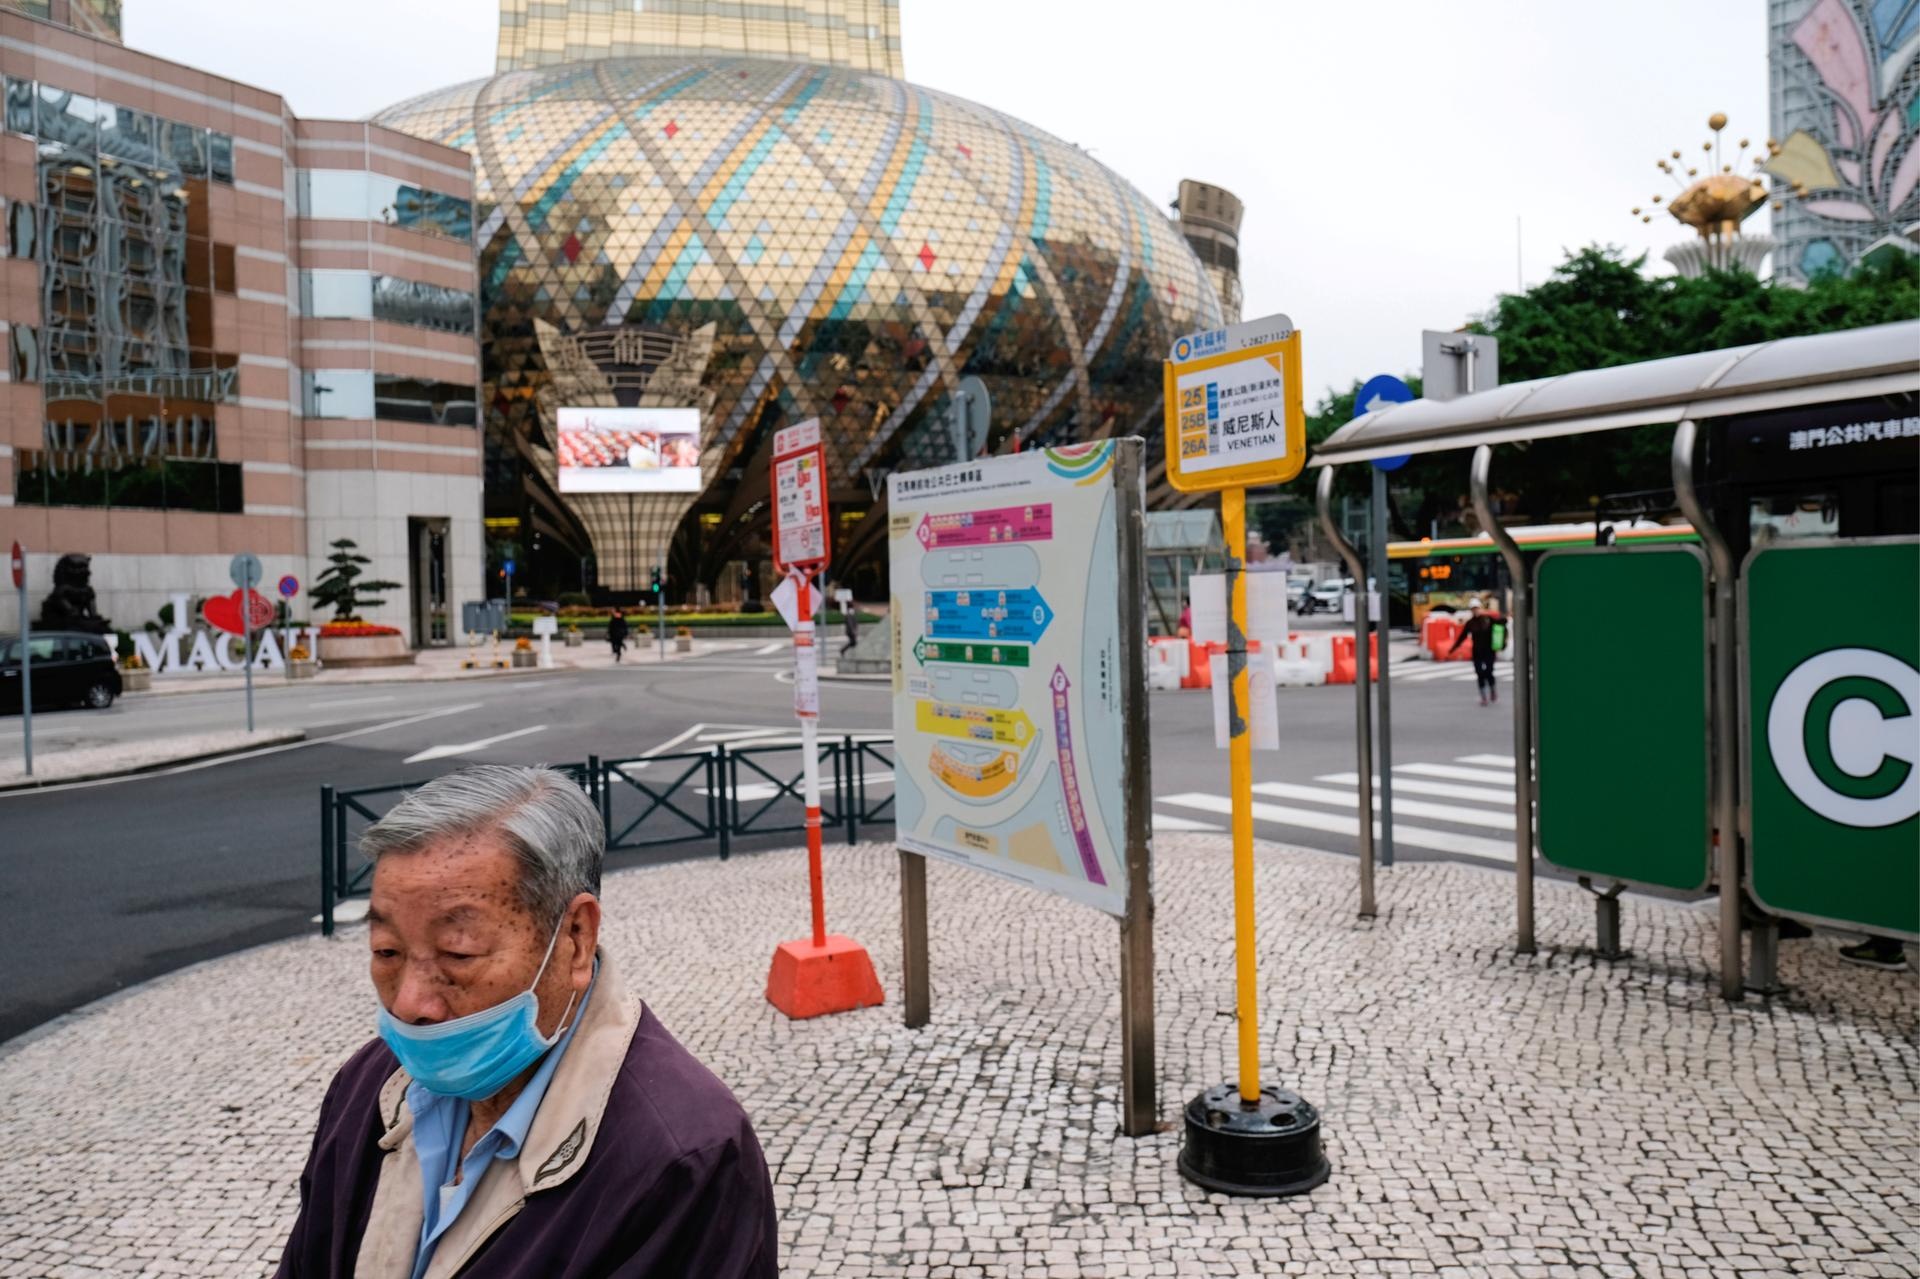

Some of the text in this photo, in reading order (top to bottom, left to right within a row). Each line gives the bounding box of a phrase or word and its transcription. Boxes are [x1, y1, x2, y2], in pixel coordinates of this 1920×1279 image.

[1193, 329, 1227, 349] 新福利
[1249, 330, 1290, 347] 2827 1122
[1184, 388, 1202, 408] 25
[1182, 412, 1206, 430] 25B
[1223, 410, 1280, 435] 威尼斯人
[1183, 438, 1206, 455] 26A
[1227, 434, 1276, 450] VENETIAN
[169, 593, 192, 636] I
[130, 627, 320, 673] MACAU
[1803, 674, 1913, 801] C
